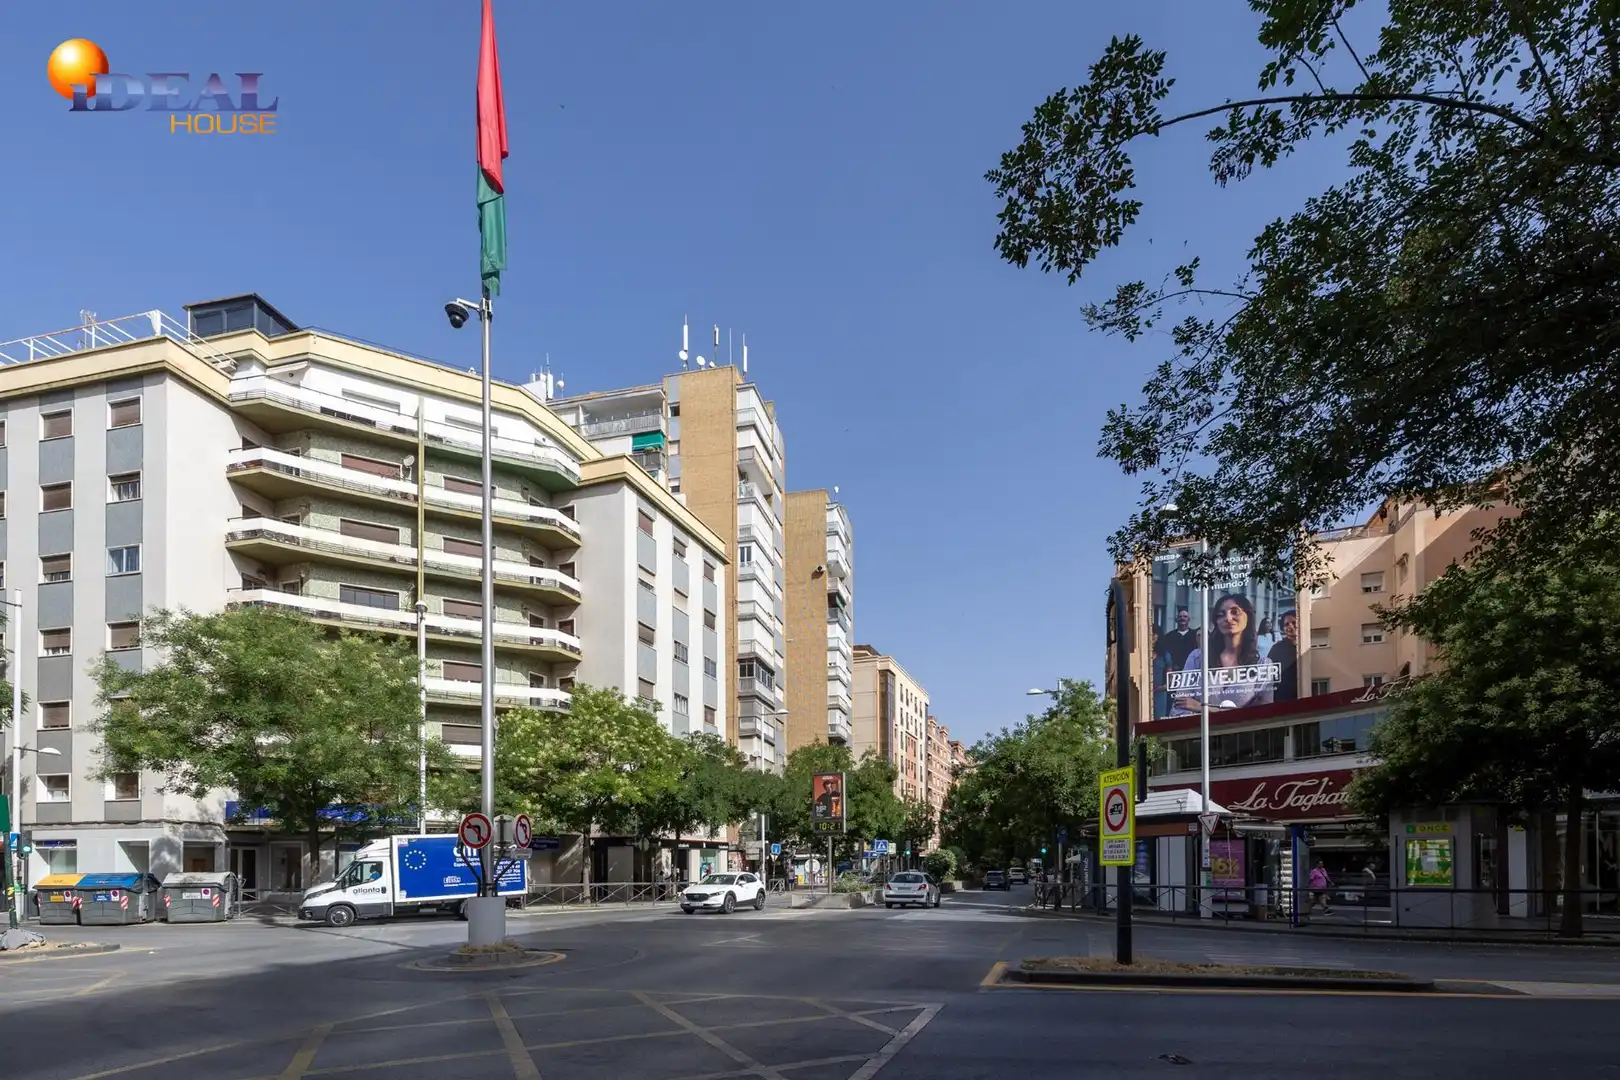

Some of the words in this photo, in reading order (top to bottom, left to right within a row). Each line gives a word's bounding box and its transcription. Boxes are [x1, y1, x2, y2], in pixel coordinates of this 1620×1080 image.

[1211, 578, 1249, 590] mundo?
[1227, 782, 1268, 810] La
[352, 887, 380, 895] atlanta
